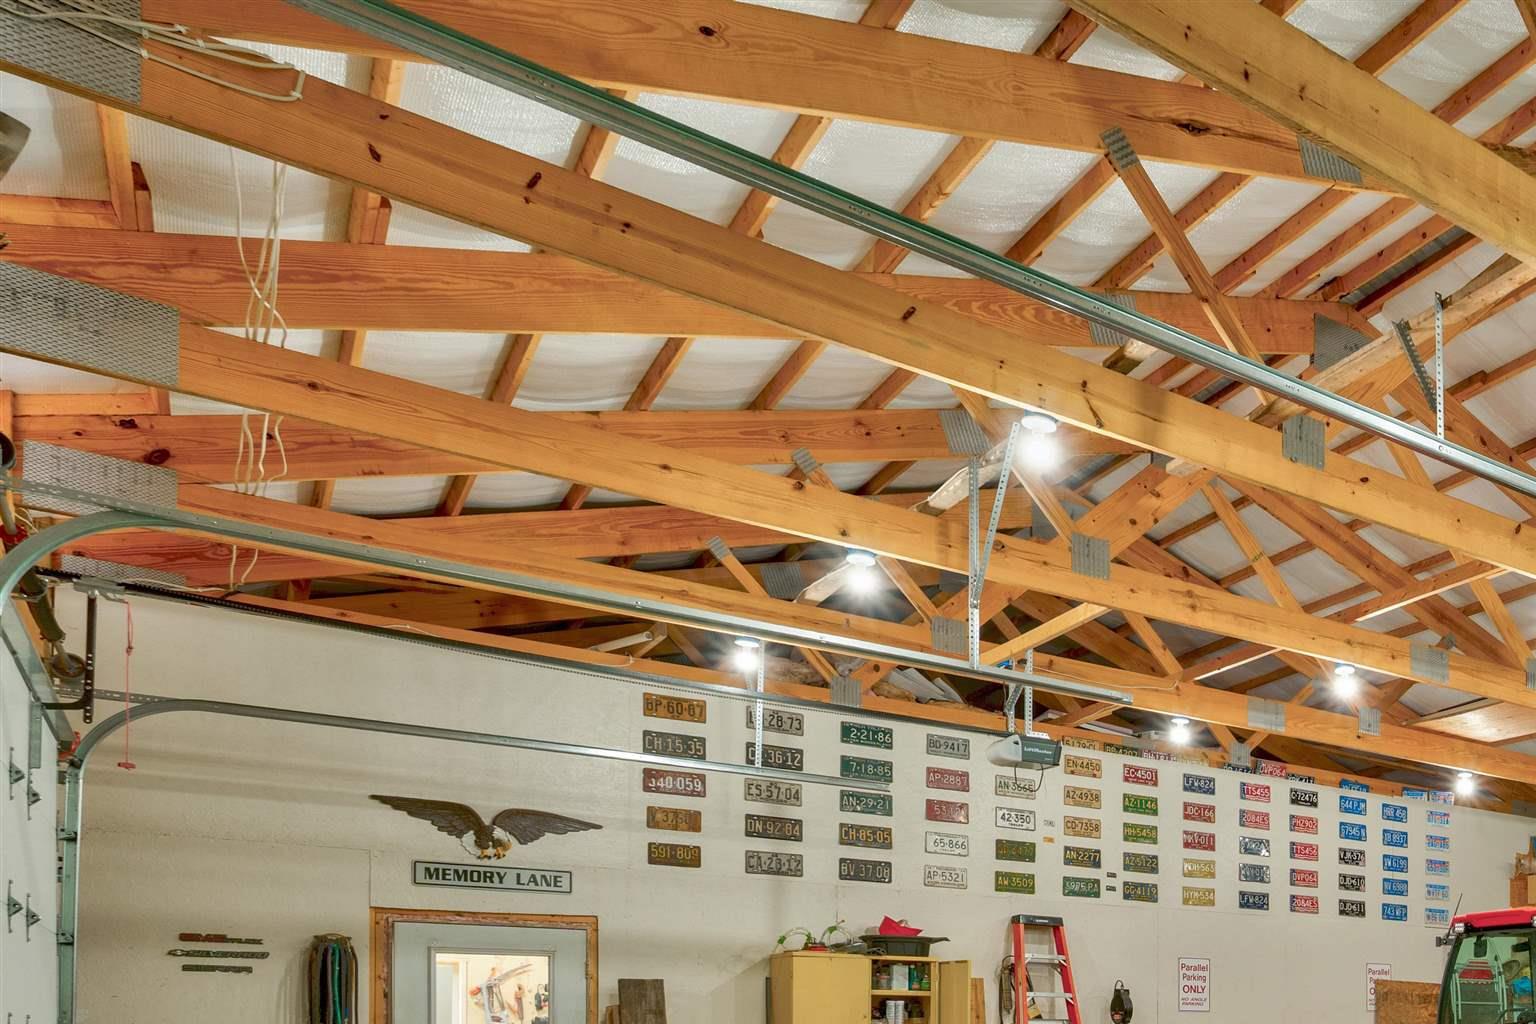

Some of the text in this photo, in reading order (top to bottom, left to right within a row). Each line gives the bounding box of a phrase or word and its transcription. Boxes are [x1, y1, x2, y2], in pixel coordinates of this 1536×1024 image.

[424, 866, 563, 888] MEMORY LANE
[1181, 962, 1209, 972] Parallel
[1368, 967, 1390, 976] Parallel
[1183, 973, 1207, 983] Parking
[1183, 984, 1206, 994] ONLY
